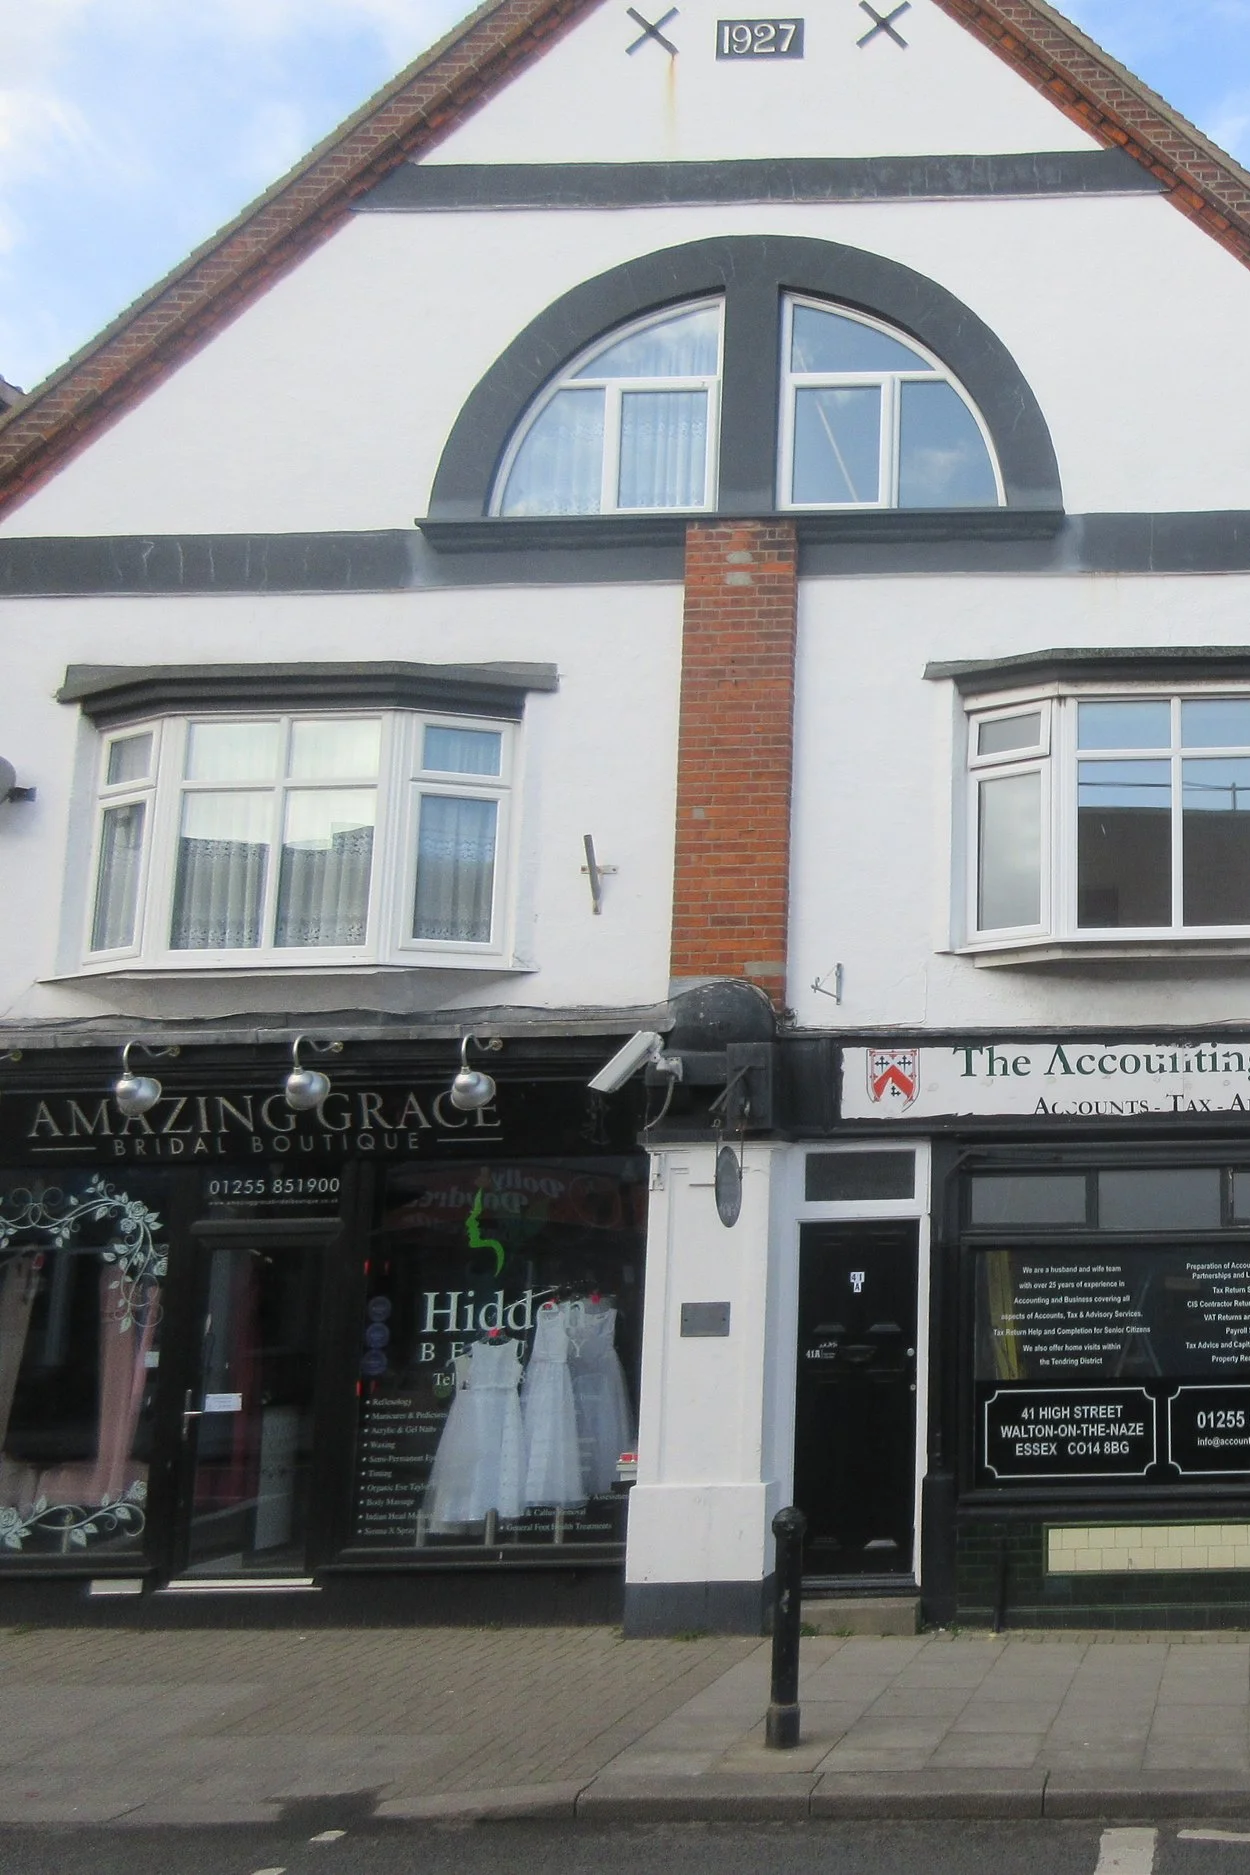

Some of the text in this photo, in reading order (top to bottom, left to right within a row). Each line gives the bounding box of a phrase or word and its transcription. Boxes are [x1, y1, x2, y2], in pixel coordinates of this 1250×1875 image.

[723, 24, 796, 54] 1927
[953, 1046, 1031, 1077] The
[28, 1091, 501, 1137] AMAZING GRACE
[114, 1132, 419, 1156] BRIDAL BOUTIQUE
[209, 1178, 340, 1195] 01255 851900
[1187, 1263, 1222, 1271] Preparation
[1192, 1272, 1231, 1280] Partnerships
[1058, 1281, 1074, 1289] years
[1084, 1281, 1117, 1289] experience
[1014, 1297, 1049, 1305] Accounting
[420, 1289, 585, 1332] Hidden
[1001, 1313, 1025, 1321] aspects
[1085, 1311, 1113, 1319] Advisory
[1028, 1328, 1042, 1336] Help
[1057, 1327, 1092, 1336] Completion
[1226, 1327, 1247, 1336] Payroll
[1052, 1358, 1078, 1366] Tendring
[1212, 1356, 1238, 1364] Property
[1022, 1406, 1123, 1419] 41 HIGH STREET
[1197, 1411, 1245, 1428] 01255
[1001, 1423, 1144, 1438] WALTON-ON-THE-NAZE
[1016, 1442, 1129, 1455] ESSEX CO14 8BG
